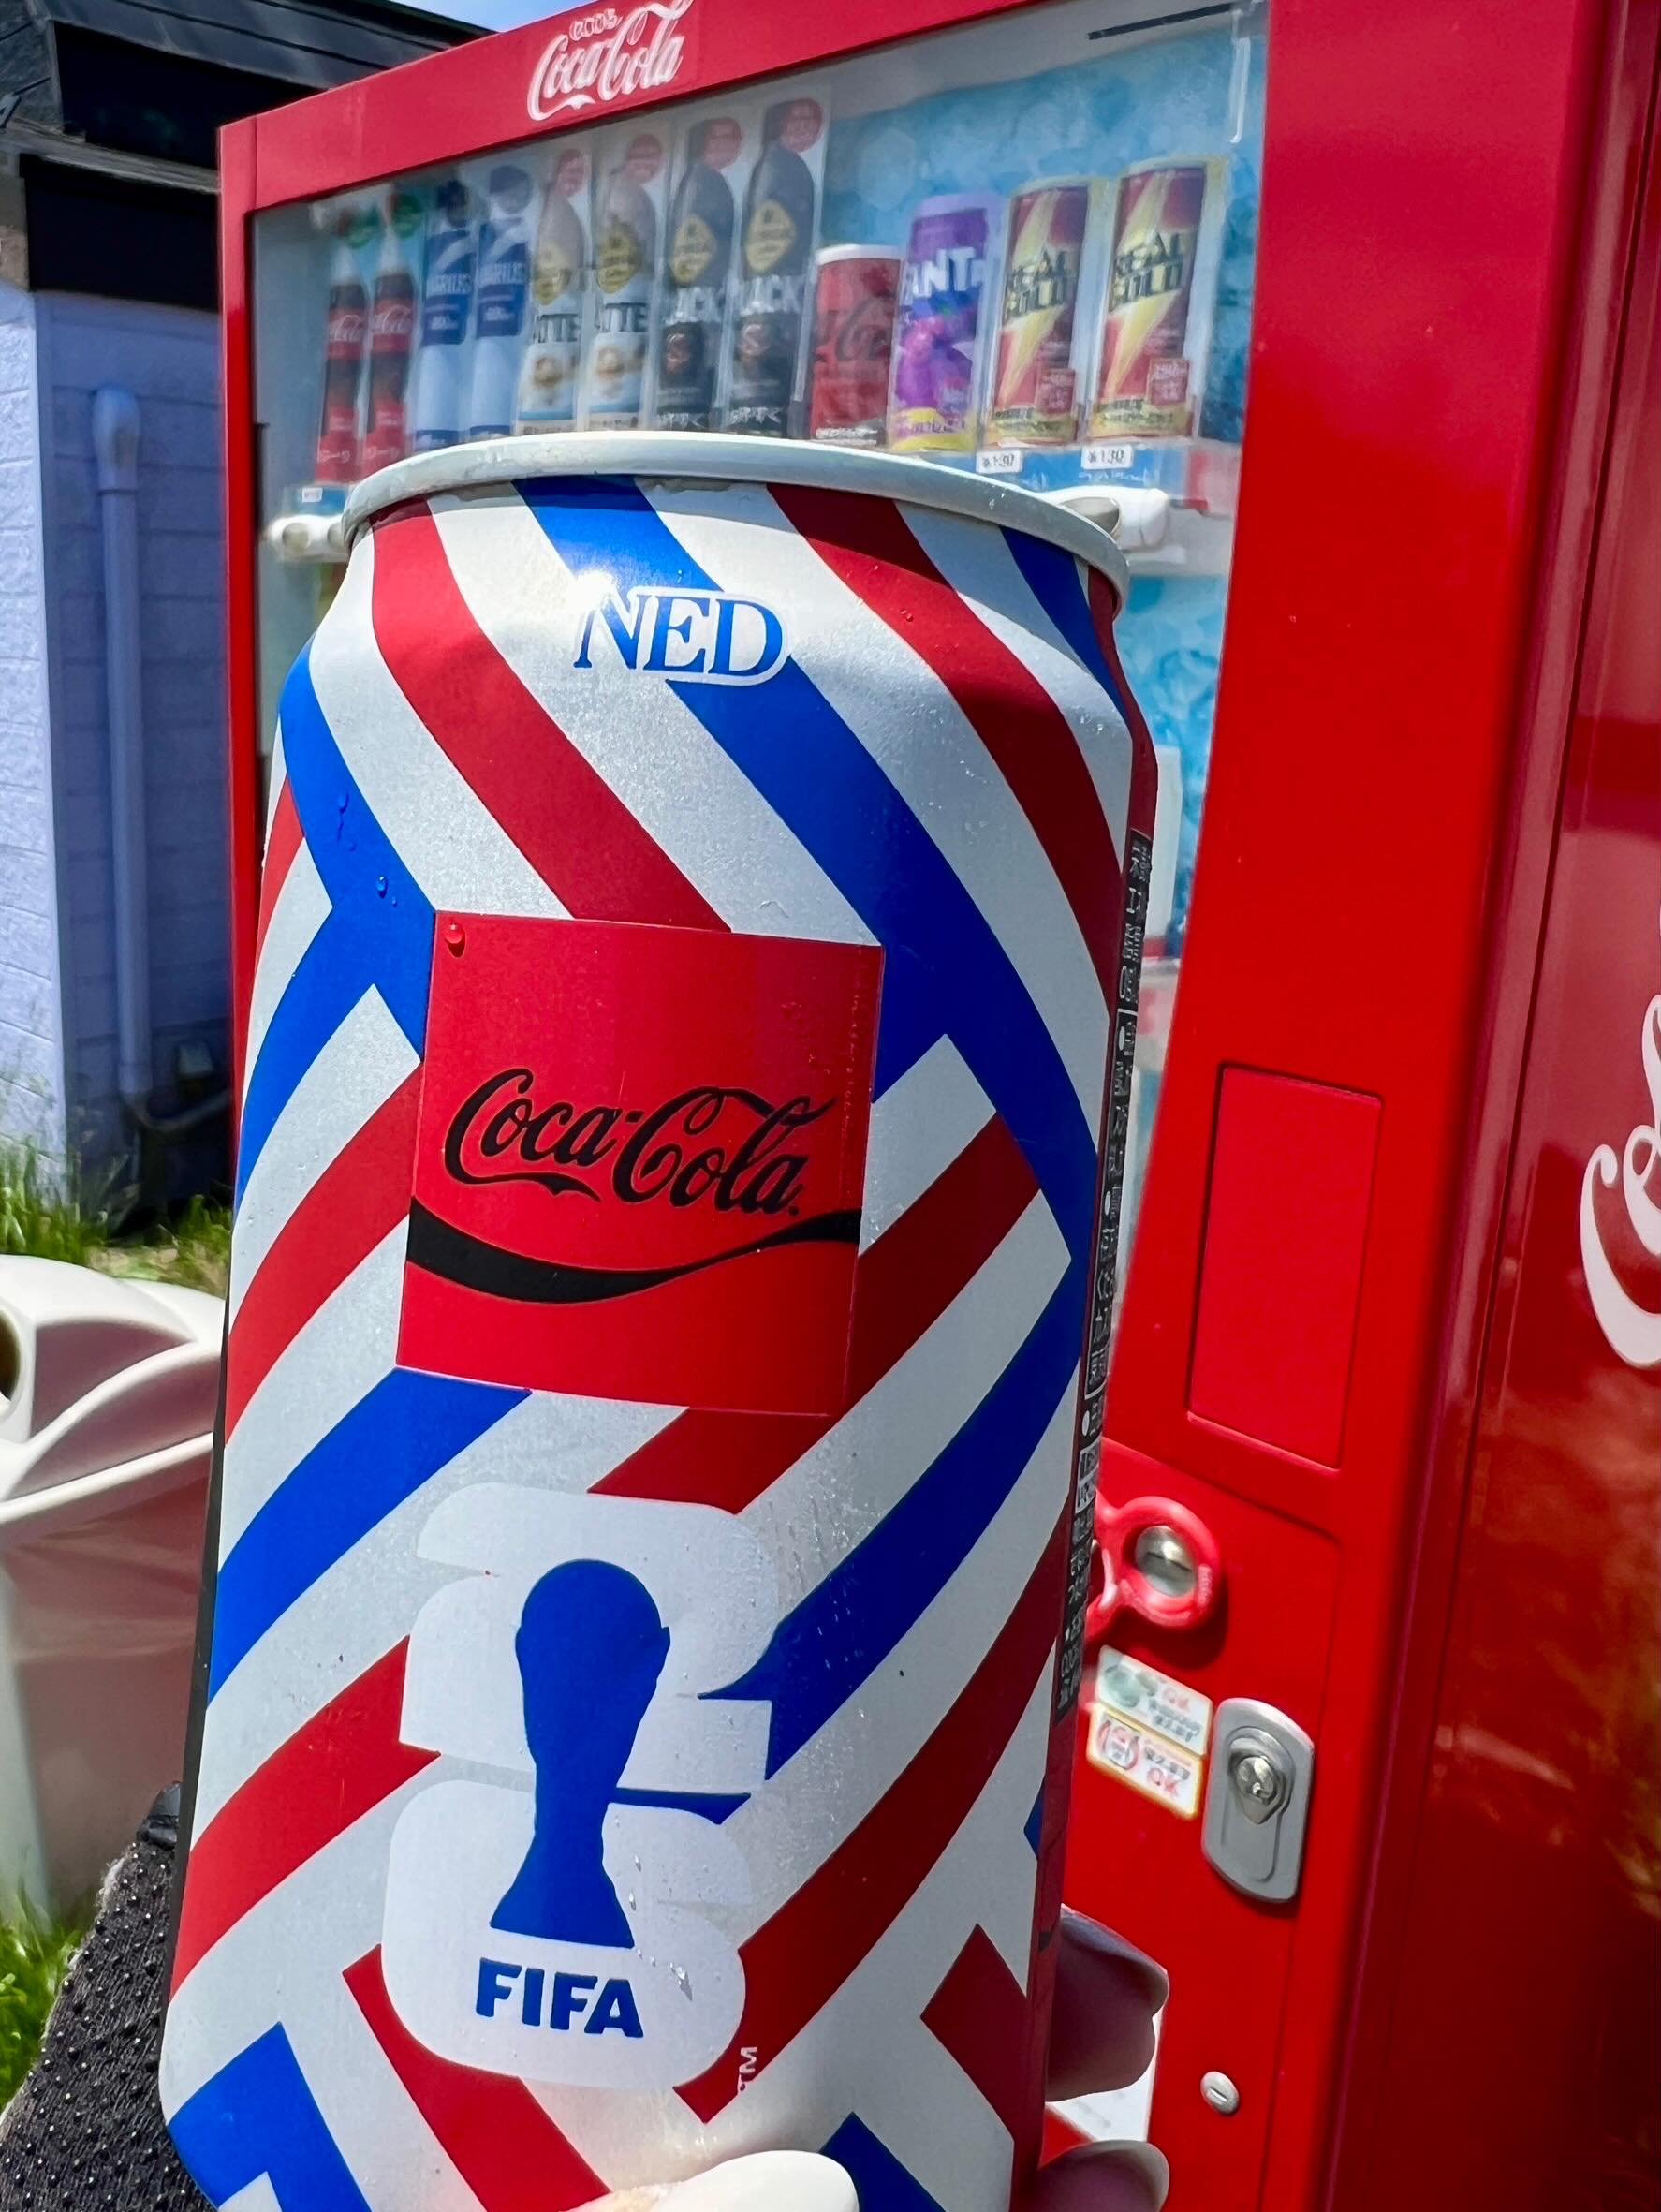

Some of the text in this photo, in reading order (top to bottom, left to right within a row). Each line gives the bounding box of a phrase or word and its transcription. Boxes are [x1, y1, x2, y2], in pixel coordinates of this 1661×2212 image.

[573, 594, 783, 677] NED
[444, 1068, 837, 1216] Coca-Cola
[475, 1956, 644, 2039] FIFA
